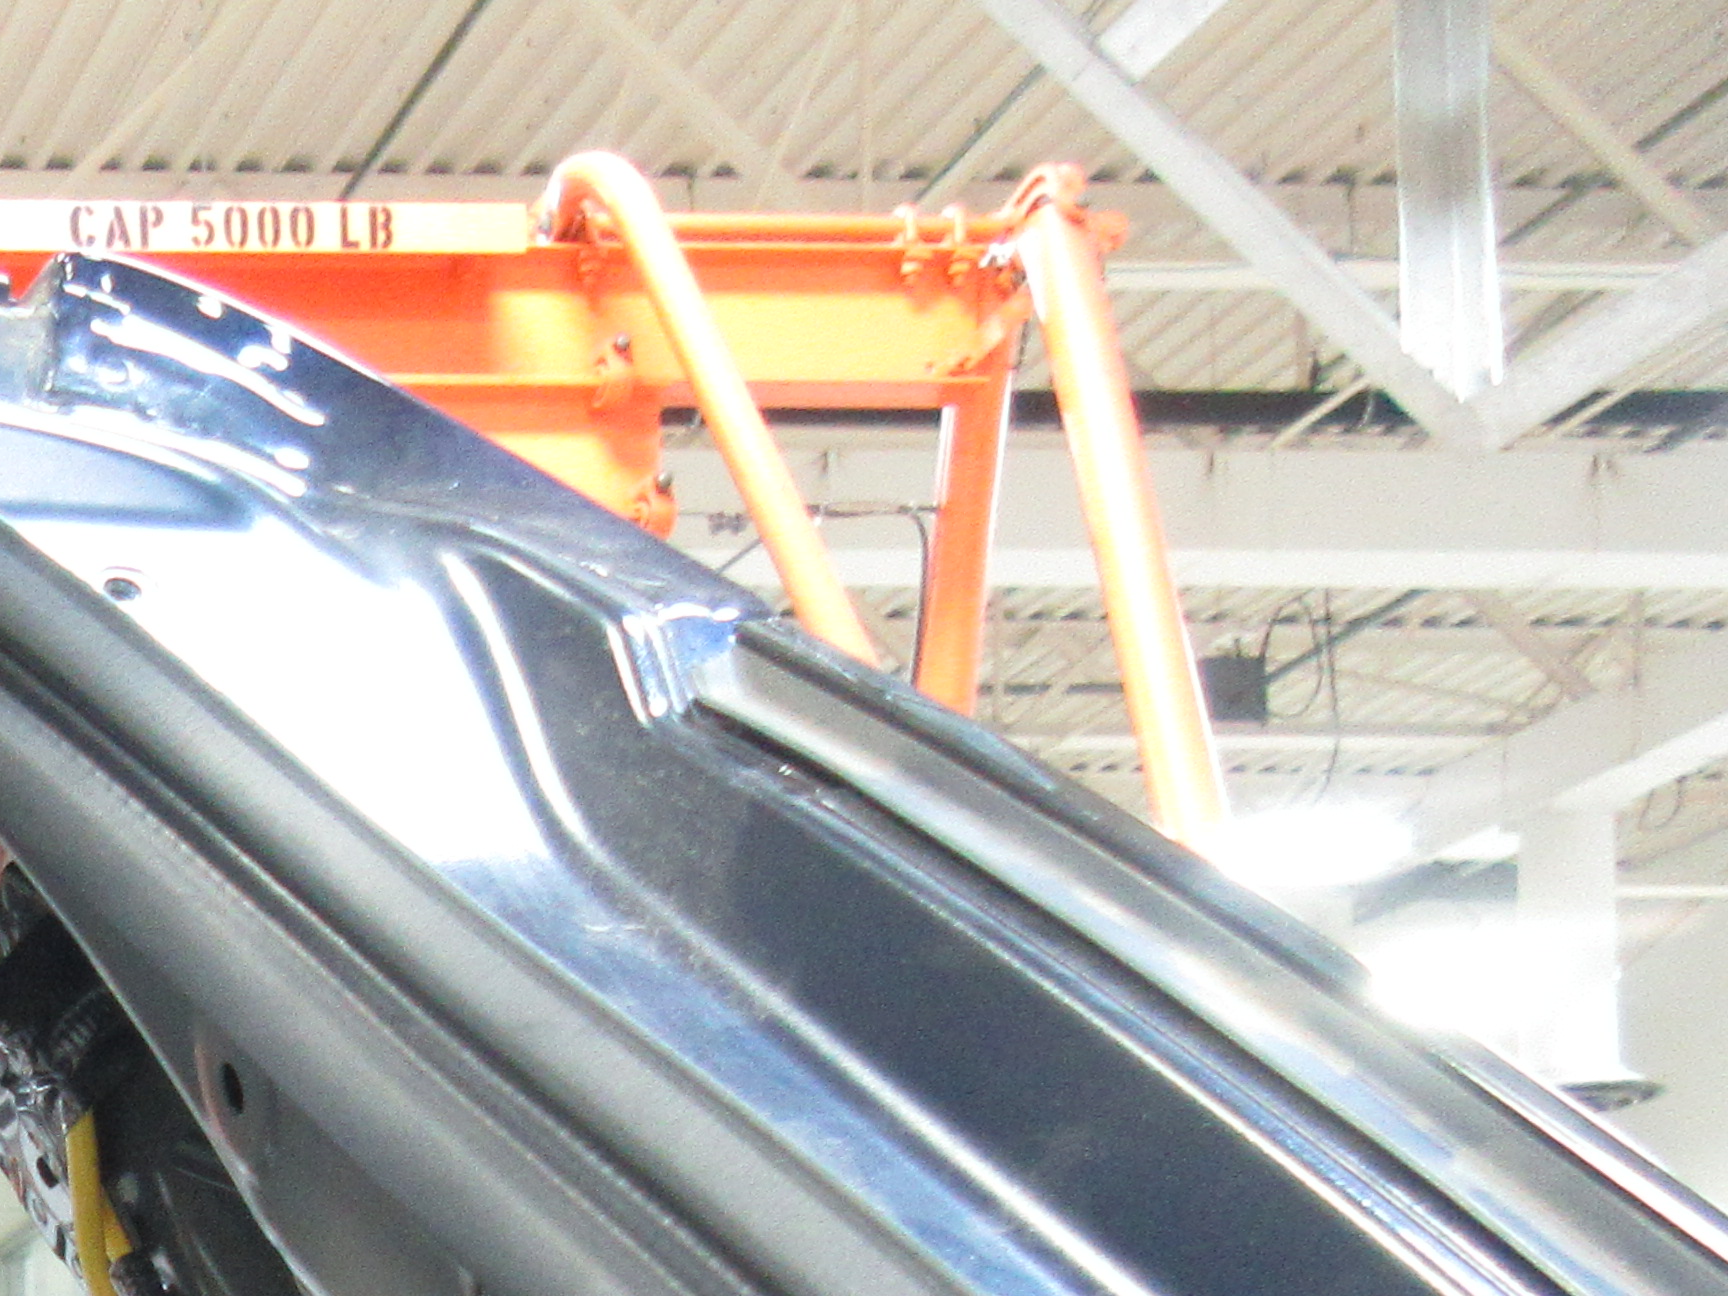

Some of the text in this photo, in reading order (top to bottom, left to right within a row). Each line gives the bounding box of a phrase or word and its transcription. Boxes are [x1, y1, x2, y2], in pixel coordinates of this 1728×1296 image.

[69, 205, 395, 250] CAP 5000 LB
